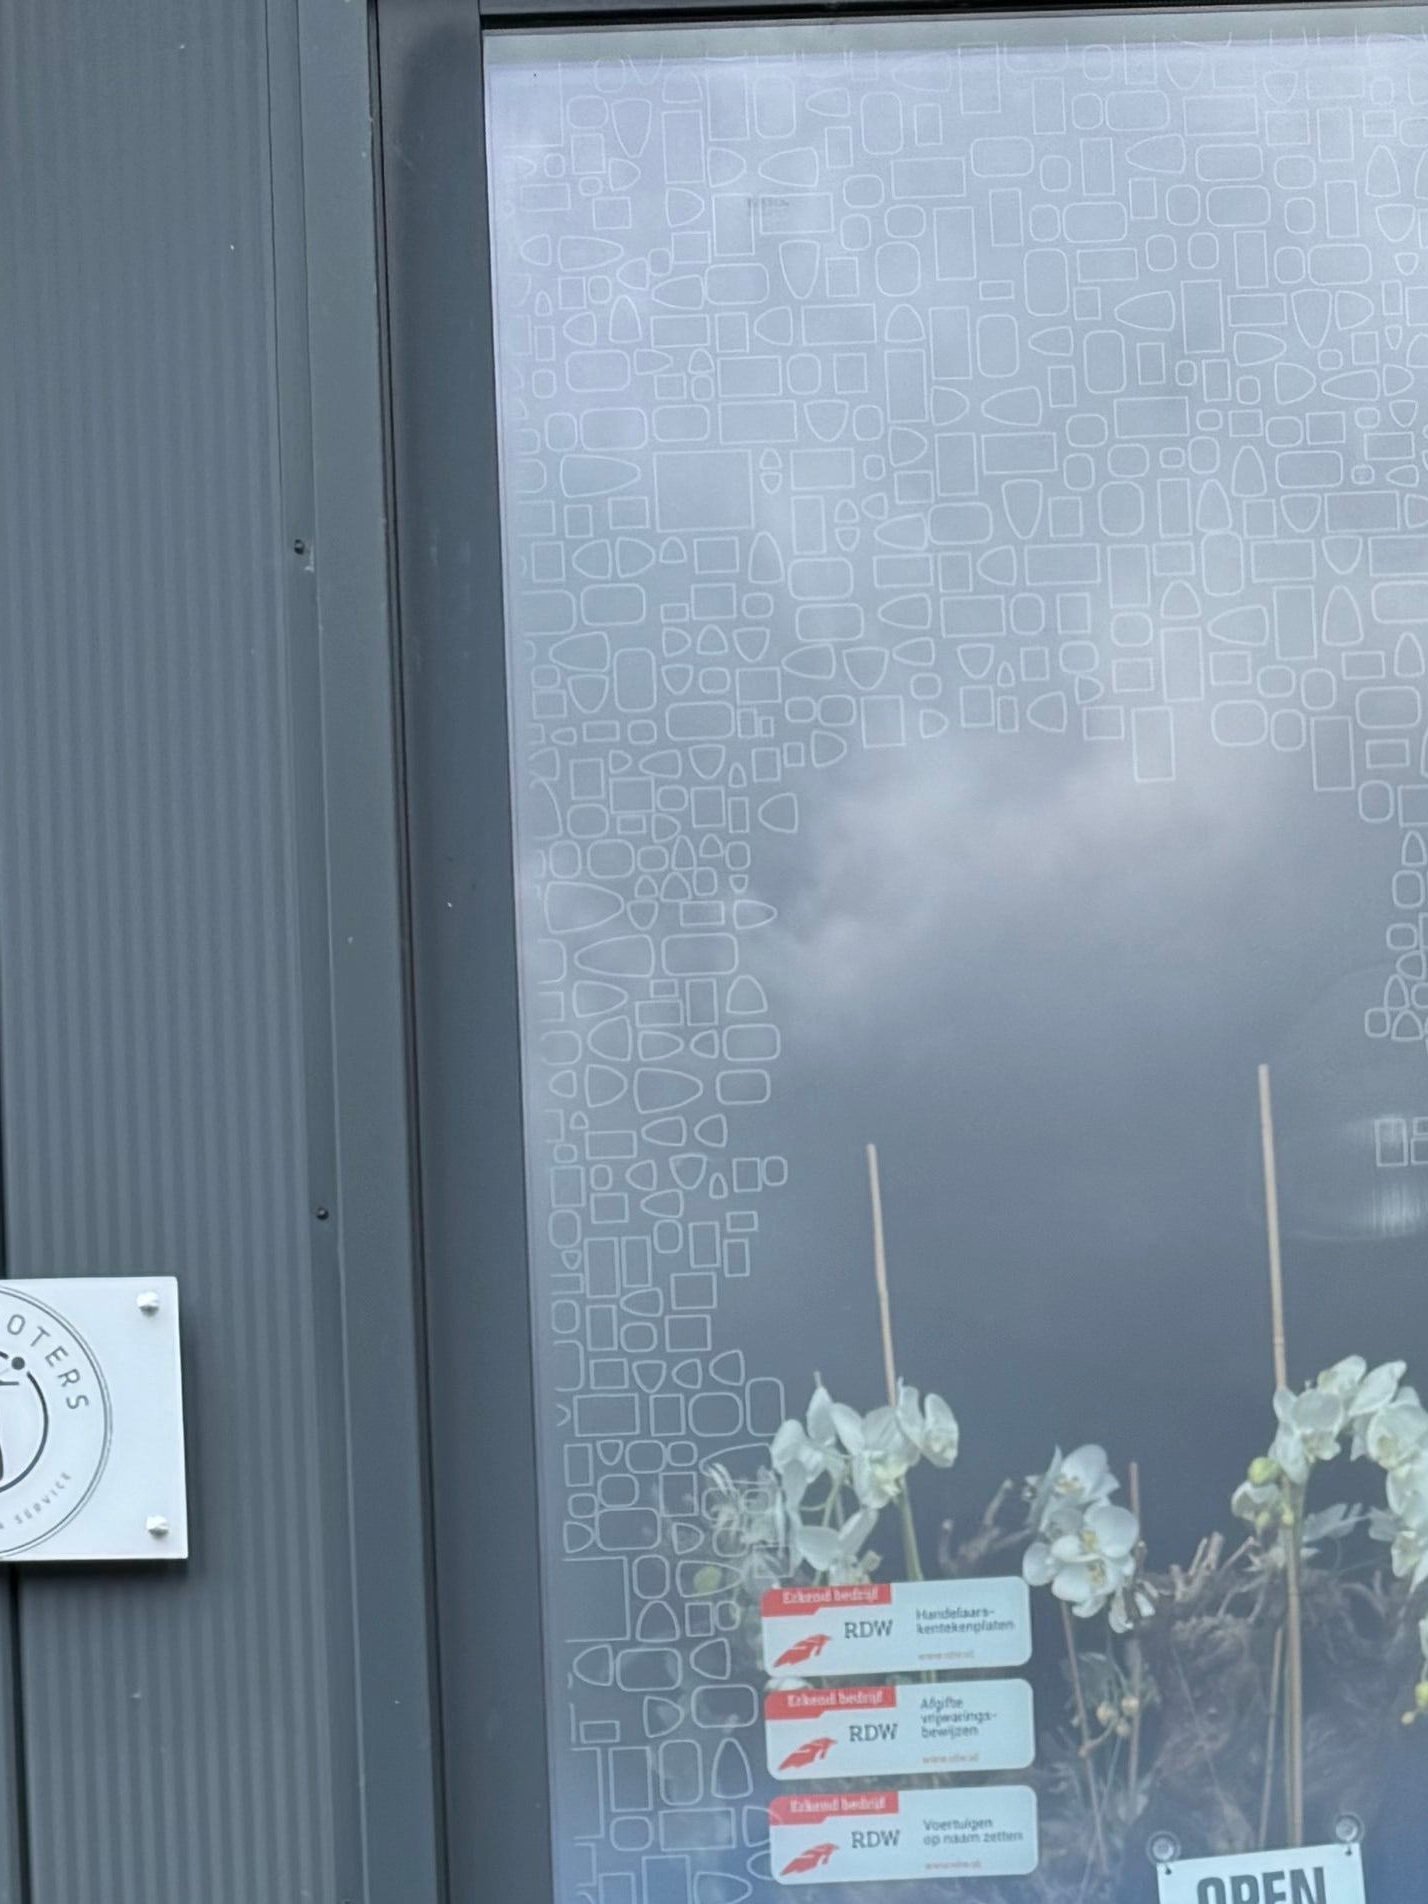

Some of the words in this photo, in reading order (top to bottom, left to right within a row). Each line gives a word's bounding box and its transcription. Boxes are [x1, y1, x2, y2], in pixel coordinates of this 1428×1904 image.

[843, 1620, 894, 1639] RDW
[848, 1723, 898, 1743] RDW
[851, 1830, 900, 1849] RDW
